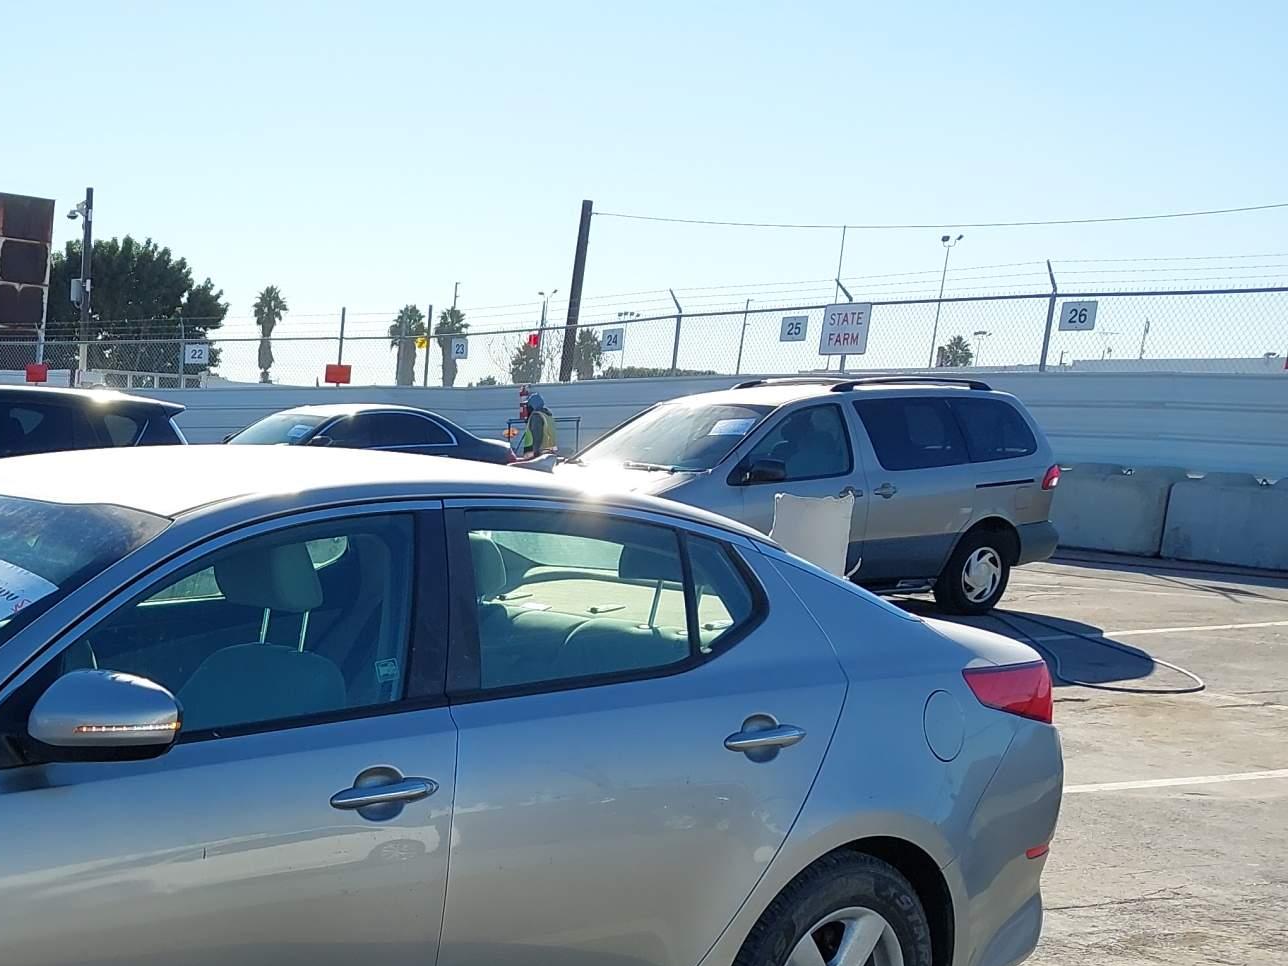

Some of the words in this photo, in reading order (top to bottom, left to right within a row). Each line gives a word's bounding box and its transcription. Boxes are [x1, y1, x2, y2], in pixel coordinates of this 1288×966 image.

[829, 311, 864, 326] STATE
[1068, 307, 1088, 324] 26
[787, 322, 802, 336] 25
[606, 334, 619, 346] 24
[827, 332, 859, 346] FARM
[190, 349, 203, 359] 22
[455, 343, 465, 355] 23
